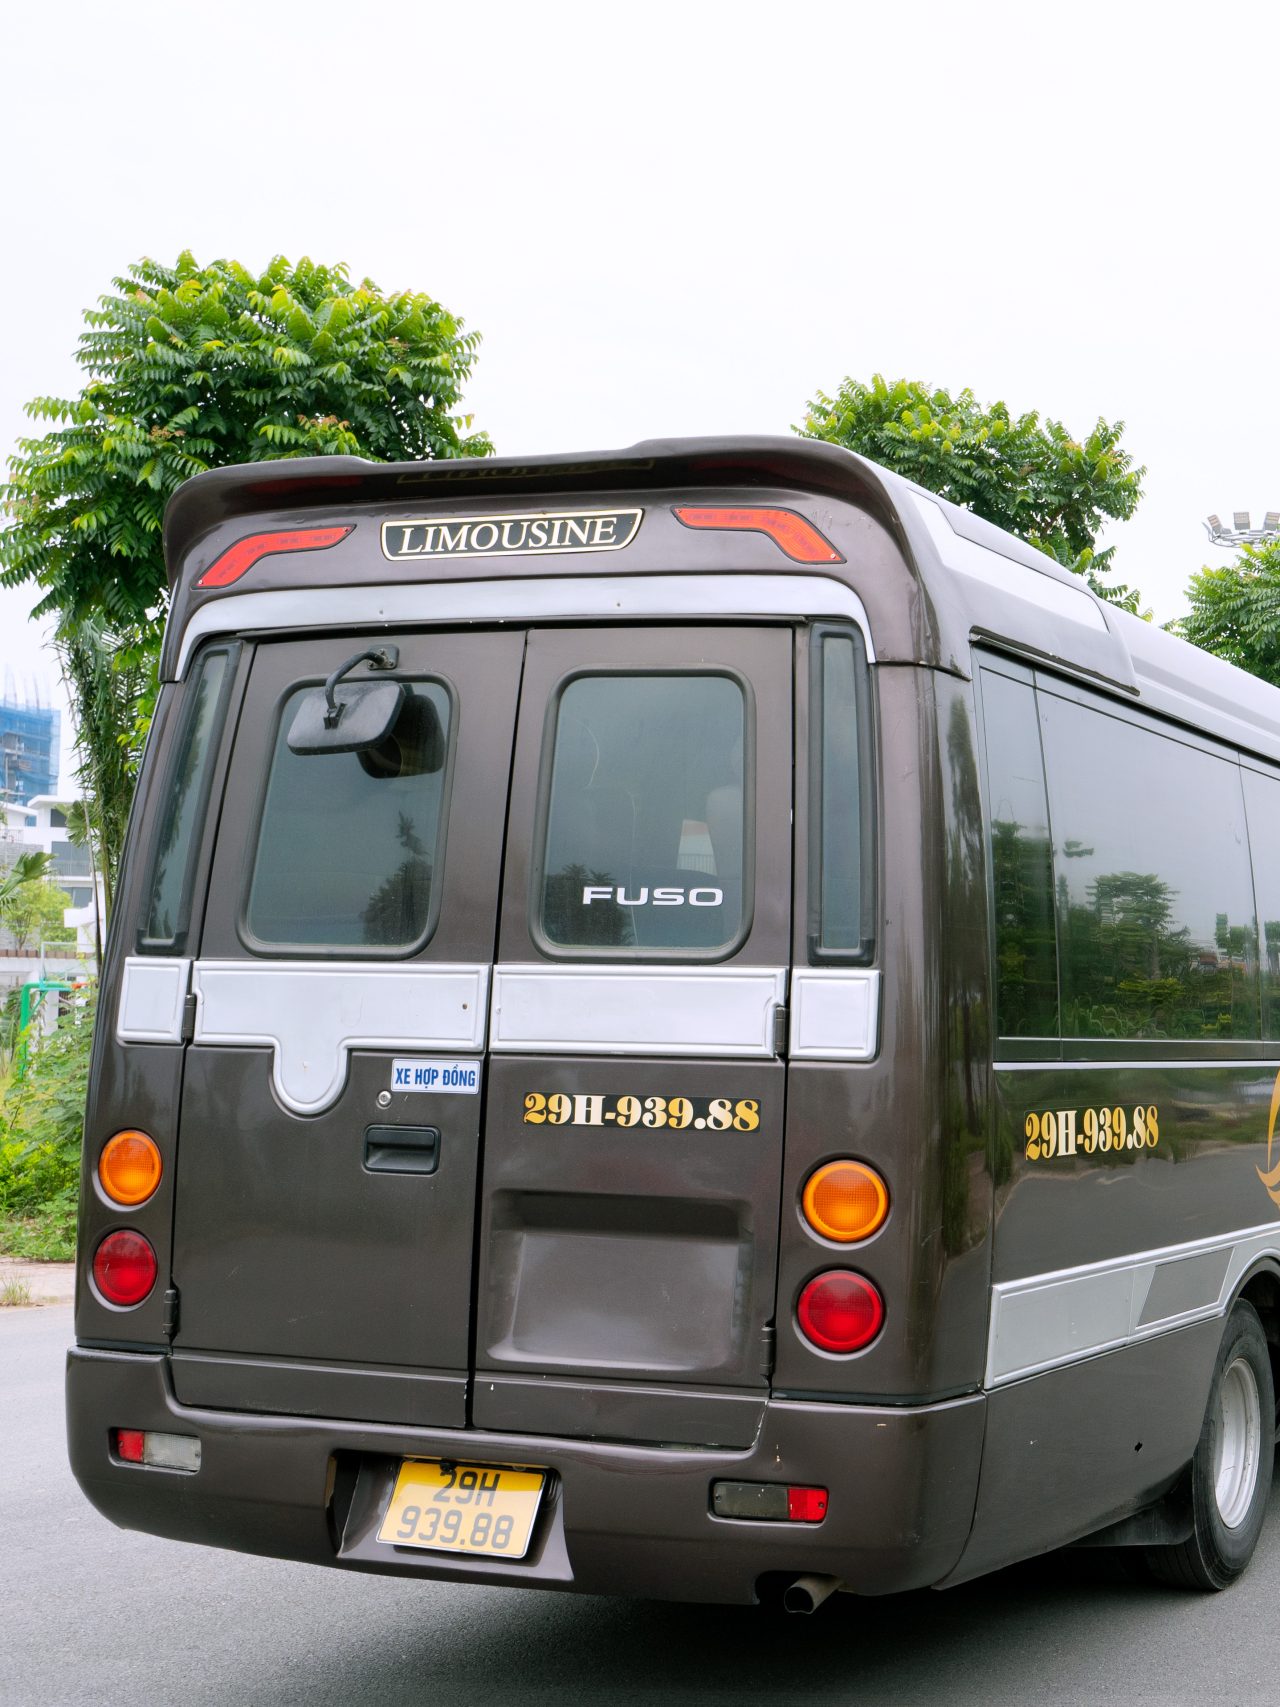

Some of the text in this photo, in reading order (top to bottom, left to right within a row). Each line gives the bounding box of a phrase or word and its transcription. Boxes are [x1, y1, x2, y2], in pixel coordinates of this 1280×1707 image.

[398, 518, 618, 554] LIMOUSINE
[582, 886, 724, 907] FUSO
[395, 1064, 476, 1089] XE HỢP ĐỒNG
[523, 1093, 760, 1132] 29H-939.88
[1025, 1105, 1159, 1161] 29H-939.88
[432, 1471, 501, 1507] 29H
[397, 1506, 515, 1549] 939.88
